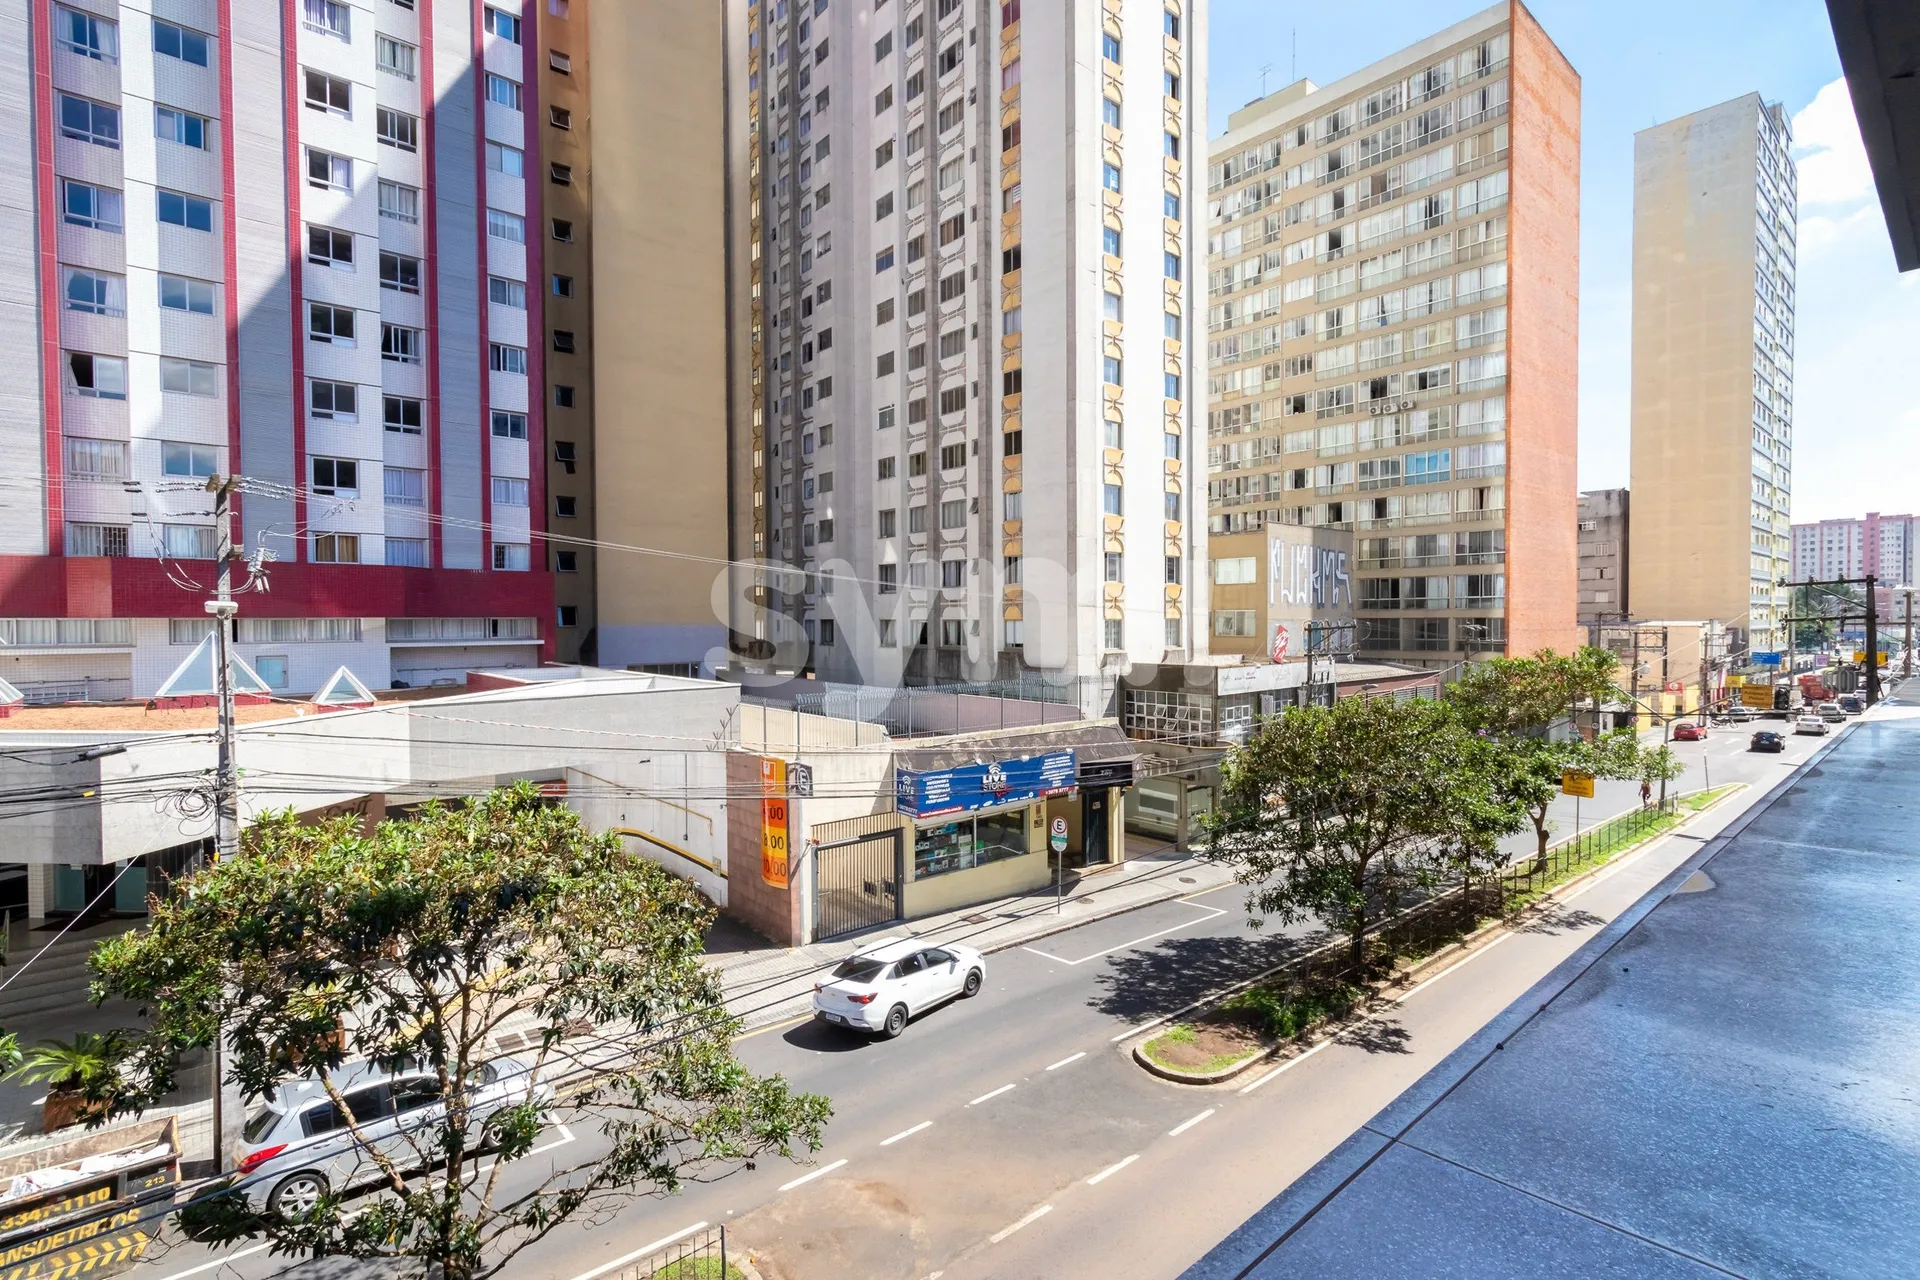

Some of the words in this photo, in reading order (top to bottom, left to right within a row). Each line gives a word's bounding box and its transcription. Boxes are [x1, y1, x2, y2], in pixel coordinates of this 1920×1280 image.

[982, 772, 1007, 784] LIVE
[898, 783, 915, 795] LIVE
[1056, 820, 1063, 831] E
[145, 1175, 165, 1188] 213
